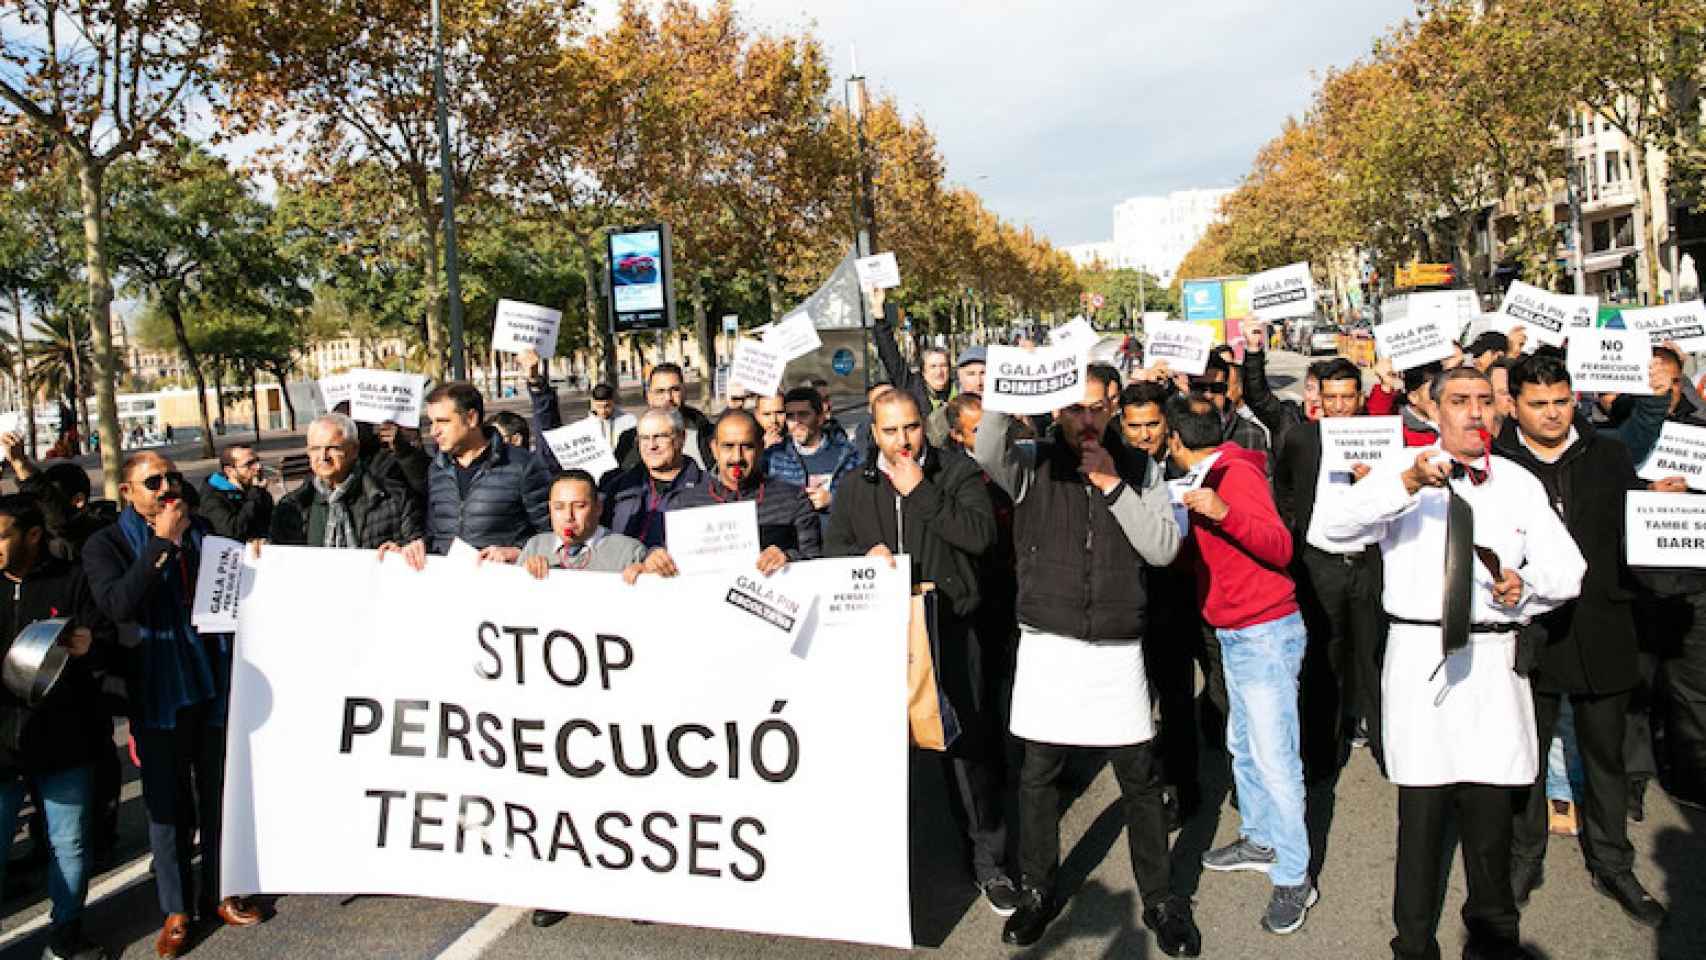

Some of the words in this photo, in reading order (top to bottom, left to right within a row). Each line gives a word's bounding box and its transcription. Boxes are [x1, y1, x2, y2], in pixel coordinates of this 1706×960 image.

[1633, 318, 1672, 330] GALA
[1385, 328, 1415, 344] GALA
[1600, 339, 1624, 352] NO
[999, 362, 1047, 376] GALA
[1052, 354, 1077, 372] PIN
[1589, 372, 1642, 381] TERRASSES
[357, 382, 389, 394] GALA
[1343, 450, 1382, 460] BARRI
[1657, 458, 1703, 475] BARRI
[1657, 537, 1705, 548] BARR
[851, 568, 877, 581] NO
[210, 578, 225, 614] GALA
[736, 574, 774, 600] GALA
[776, 593, 801, 613] PIN
[475, 621, 634, 690] STOP
[339, 696, 800, 783] PERSECUCIÓ
[365, 789, 768, 882] TERRASSES
